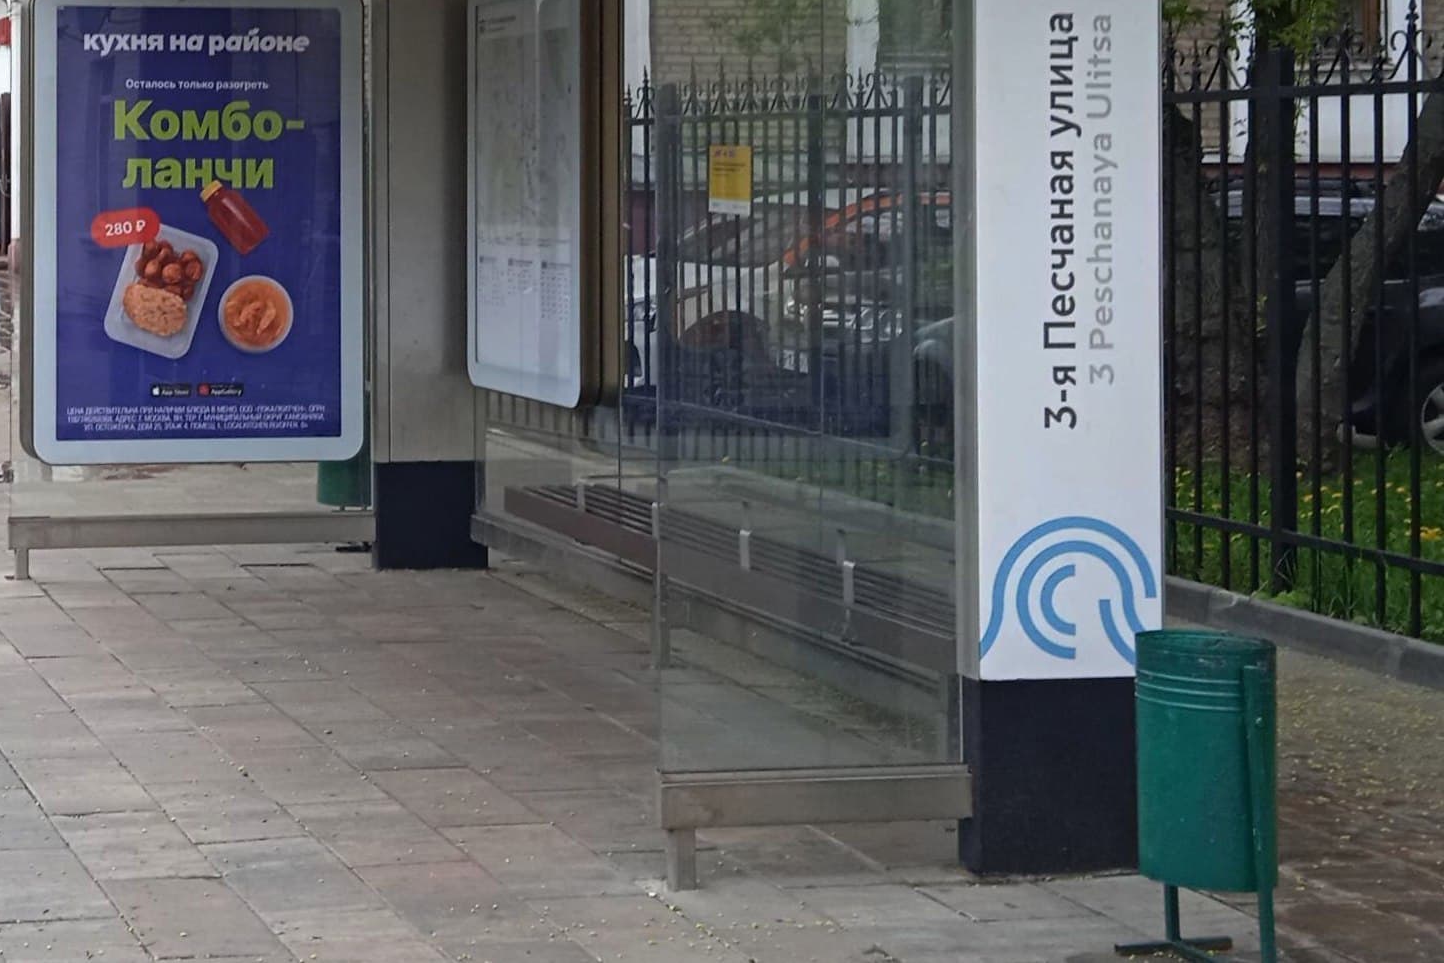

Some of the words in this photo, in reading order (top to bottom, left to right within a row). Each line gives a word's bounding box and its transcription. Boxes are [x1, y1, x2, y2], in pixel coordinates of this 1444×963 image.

[83, 33, 164, 57] кухня
[169, 34, 204, 52] на
[209, 28, 310, 56] районе
[125, 78, 176, 89] Осталось
[178, 79, 214, 89] только
[216, 79, 269, 91] разогреть
[1049, 12, 1082, 138] улица
[1086, 13, 1112, 119] Ulitsa
[114, 100, 305, 141] Комбо-
[122, 157, 274, 189] ланчи
[105, 221, 133, 237] 280
[1087, 132, 1118, 350] Peschanaya
[1044, 150, 1076, 350] Песчаная
[1090, 363, 1115, 385] 3
[1044, 365, 1077, 429] 3-я
